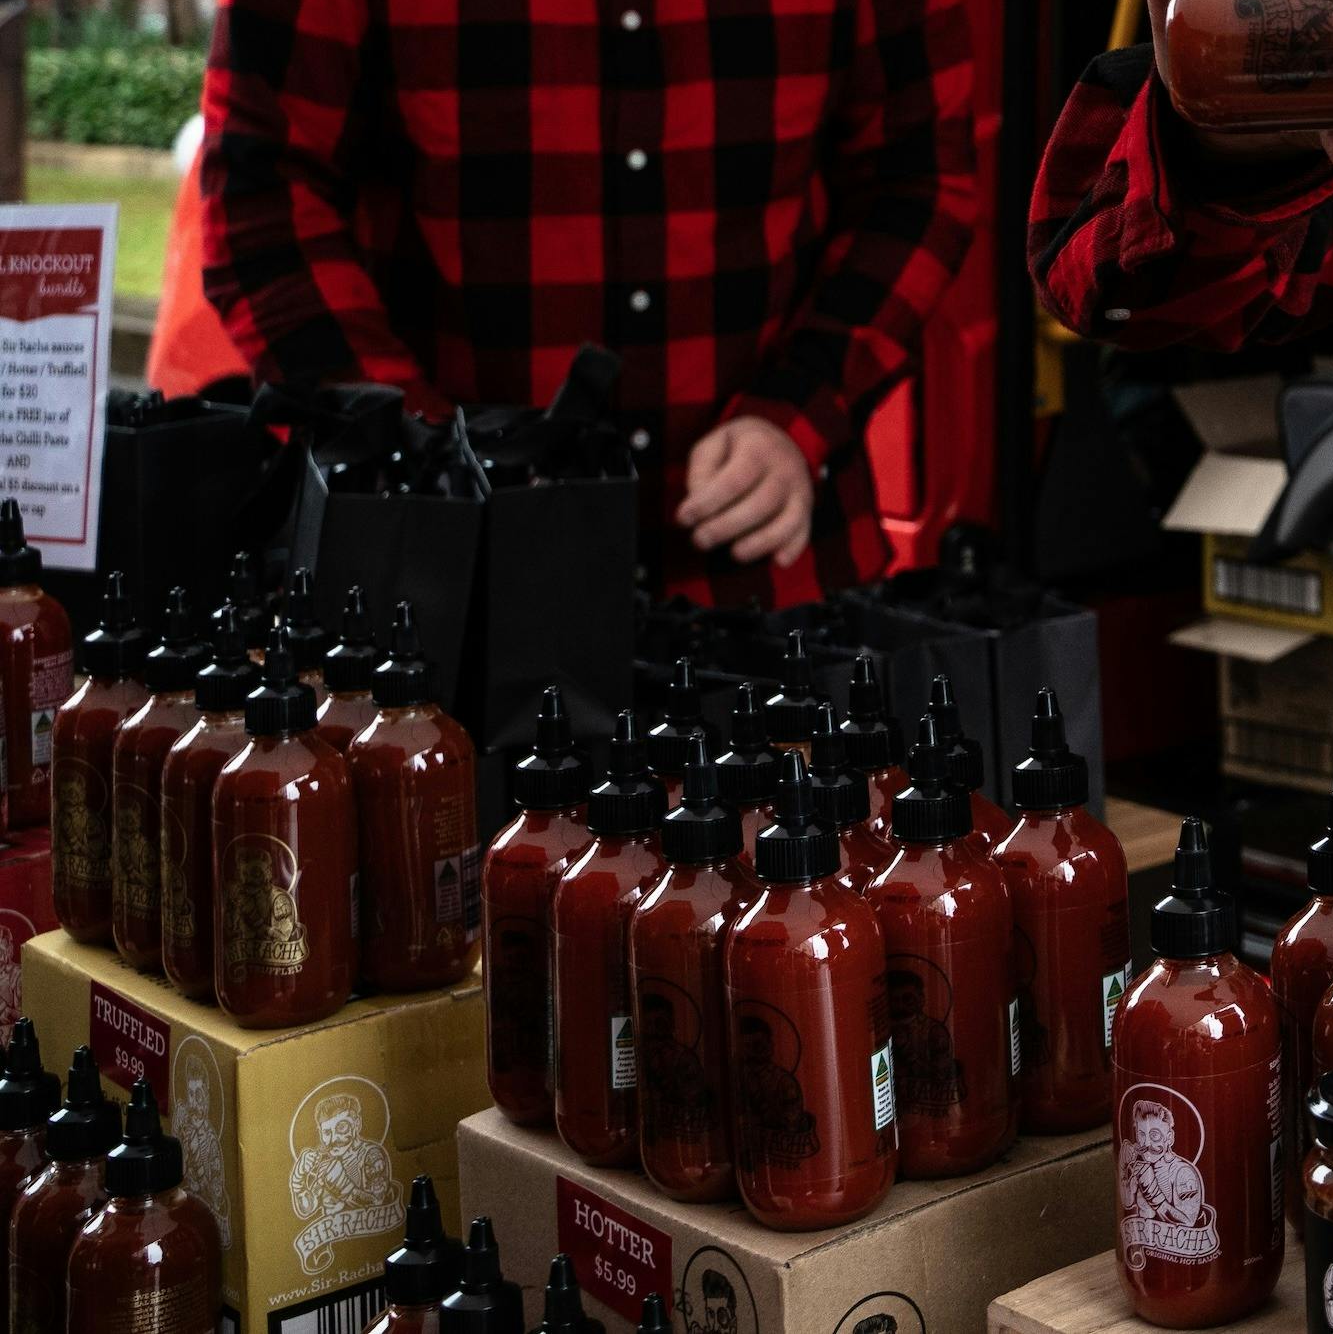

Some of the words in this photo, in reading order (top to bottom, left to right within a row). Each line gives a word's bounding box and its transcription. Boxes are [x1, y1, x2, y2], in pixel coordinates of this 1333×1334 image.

[9, 253, 95, 275] KNOCKOUT
[7, 453, 31, 467] AND
[93, 994, 166, 1058] TRUFFLED
[114, 1046, 146, 1080] $9.99
[573, 1198, 657, 1270] HOTTER
[1145, 1249, 1180, 1264] ORIGINAL
[1179, 1256, 1197, 1266] HOT
[594, 1255, 638, 1297] $5.99
